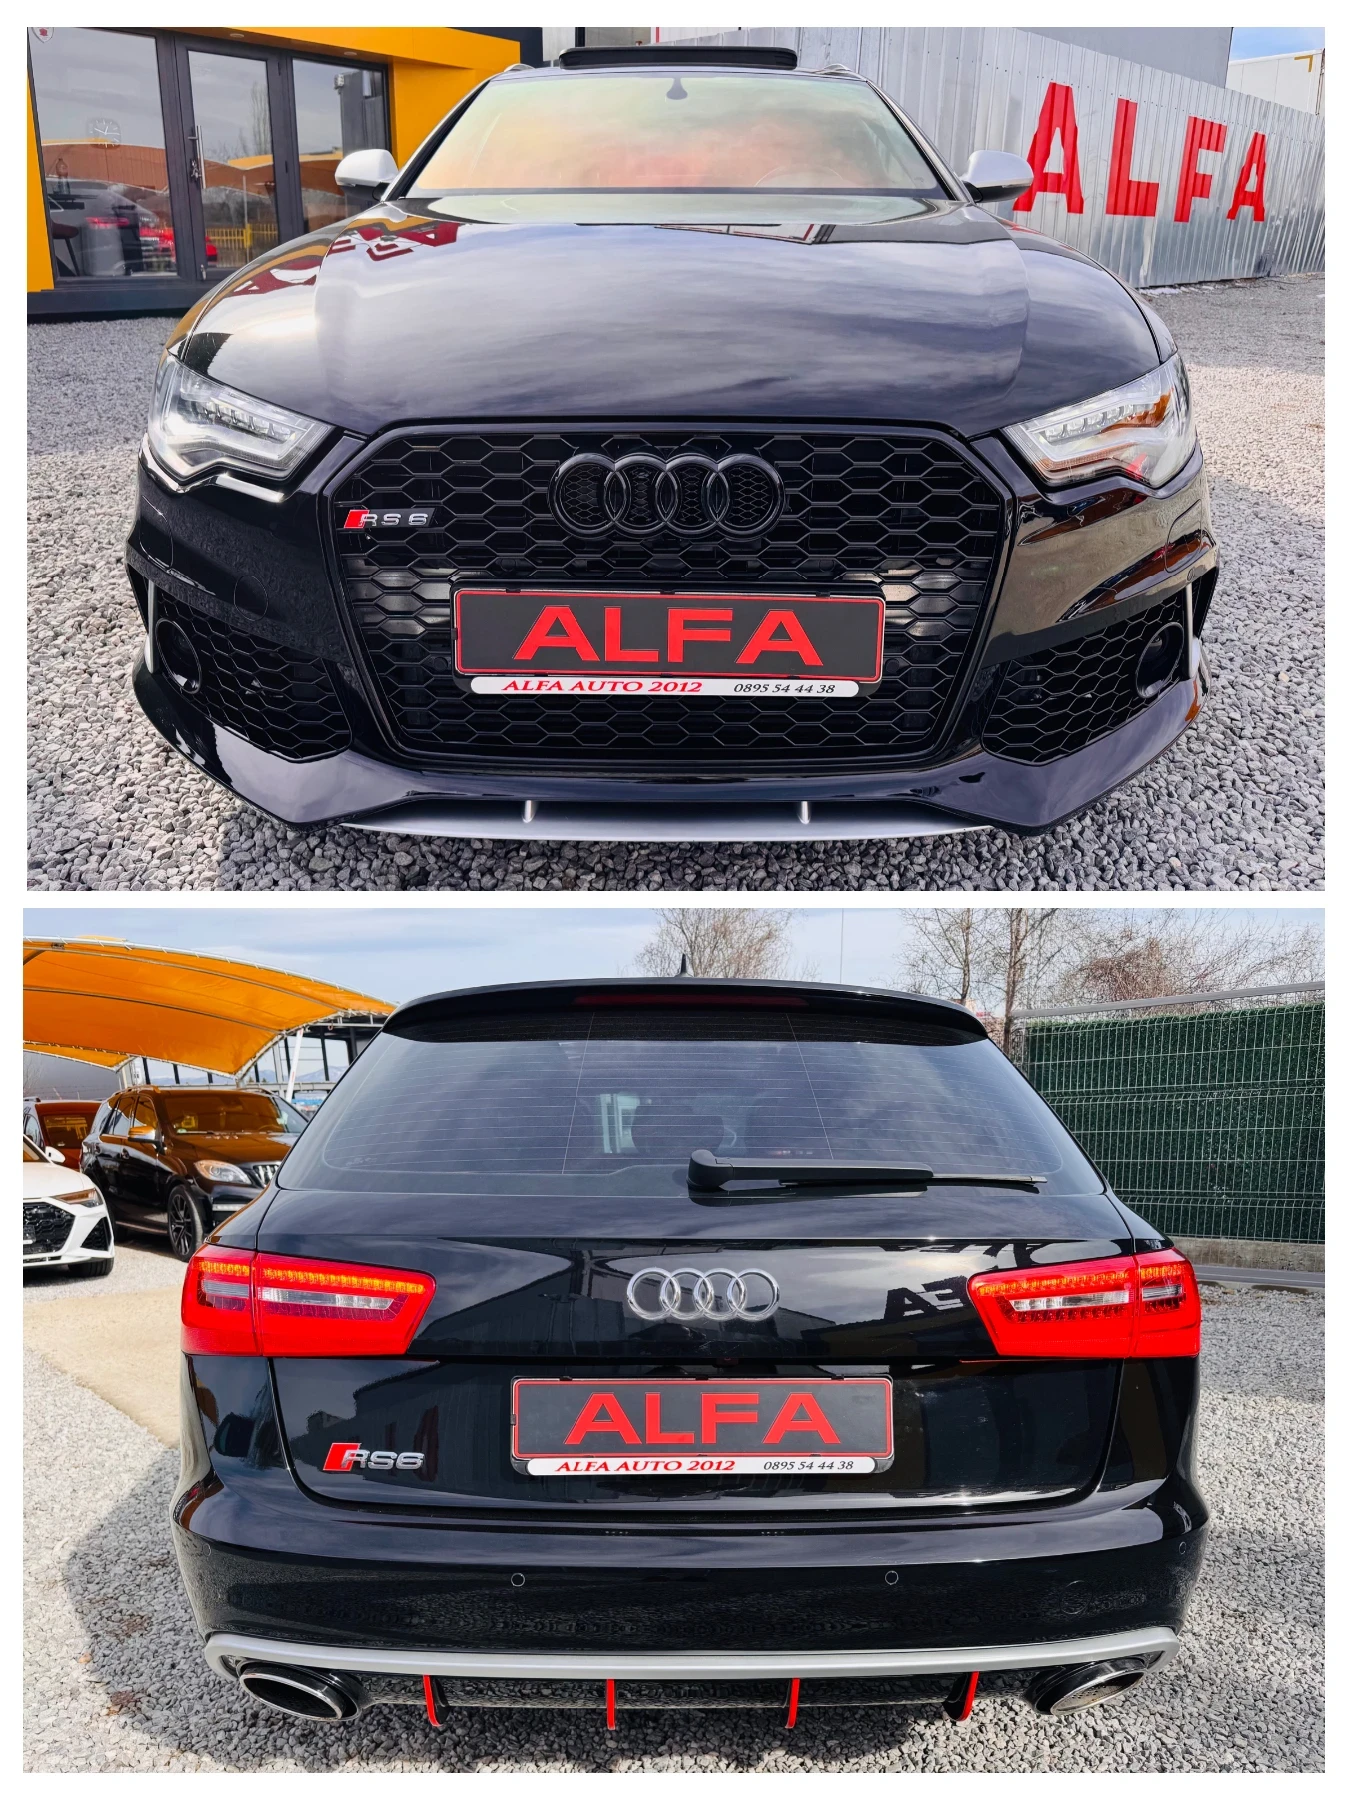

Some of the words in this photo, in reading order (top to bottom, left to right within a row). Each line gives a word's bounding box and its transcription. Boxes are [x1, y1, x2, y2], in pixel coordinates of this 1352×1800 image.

[1013, 82, 1266, 222] ALFA
[512, 605, 824, 666] ALFA
[501, 680, 561, 691] ALFA
[570, 681, 643, 692] AUTO
[649, 681, 703, 693] 2012
[734, 683, 769, 693] 0895
[772, 683, 790, 693] 54
[795, 683, 813, 693] 44
[817, 684, 836, 694] 38
[563, 1392, 841, 1445] ALFA
[341, 1449, 425, 1470] RS6
[556, 1461, 611, 1472] ALFA
[615, 1460, 682, 1471] AUTO
[687, 1460, 736, 1471] 2012
[763, 1460, 795, 1470] 0895
[798, 1460, 814, 1470] 54
[818, 1460, 835, 1470] 44
[837, 1460, 854, 1470] 38
